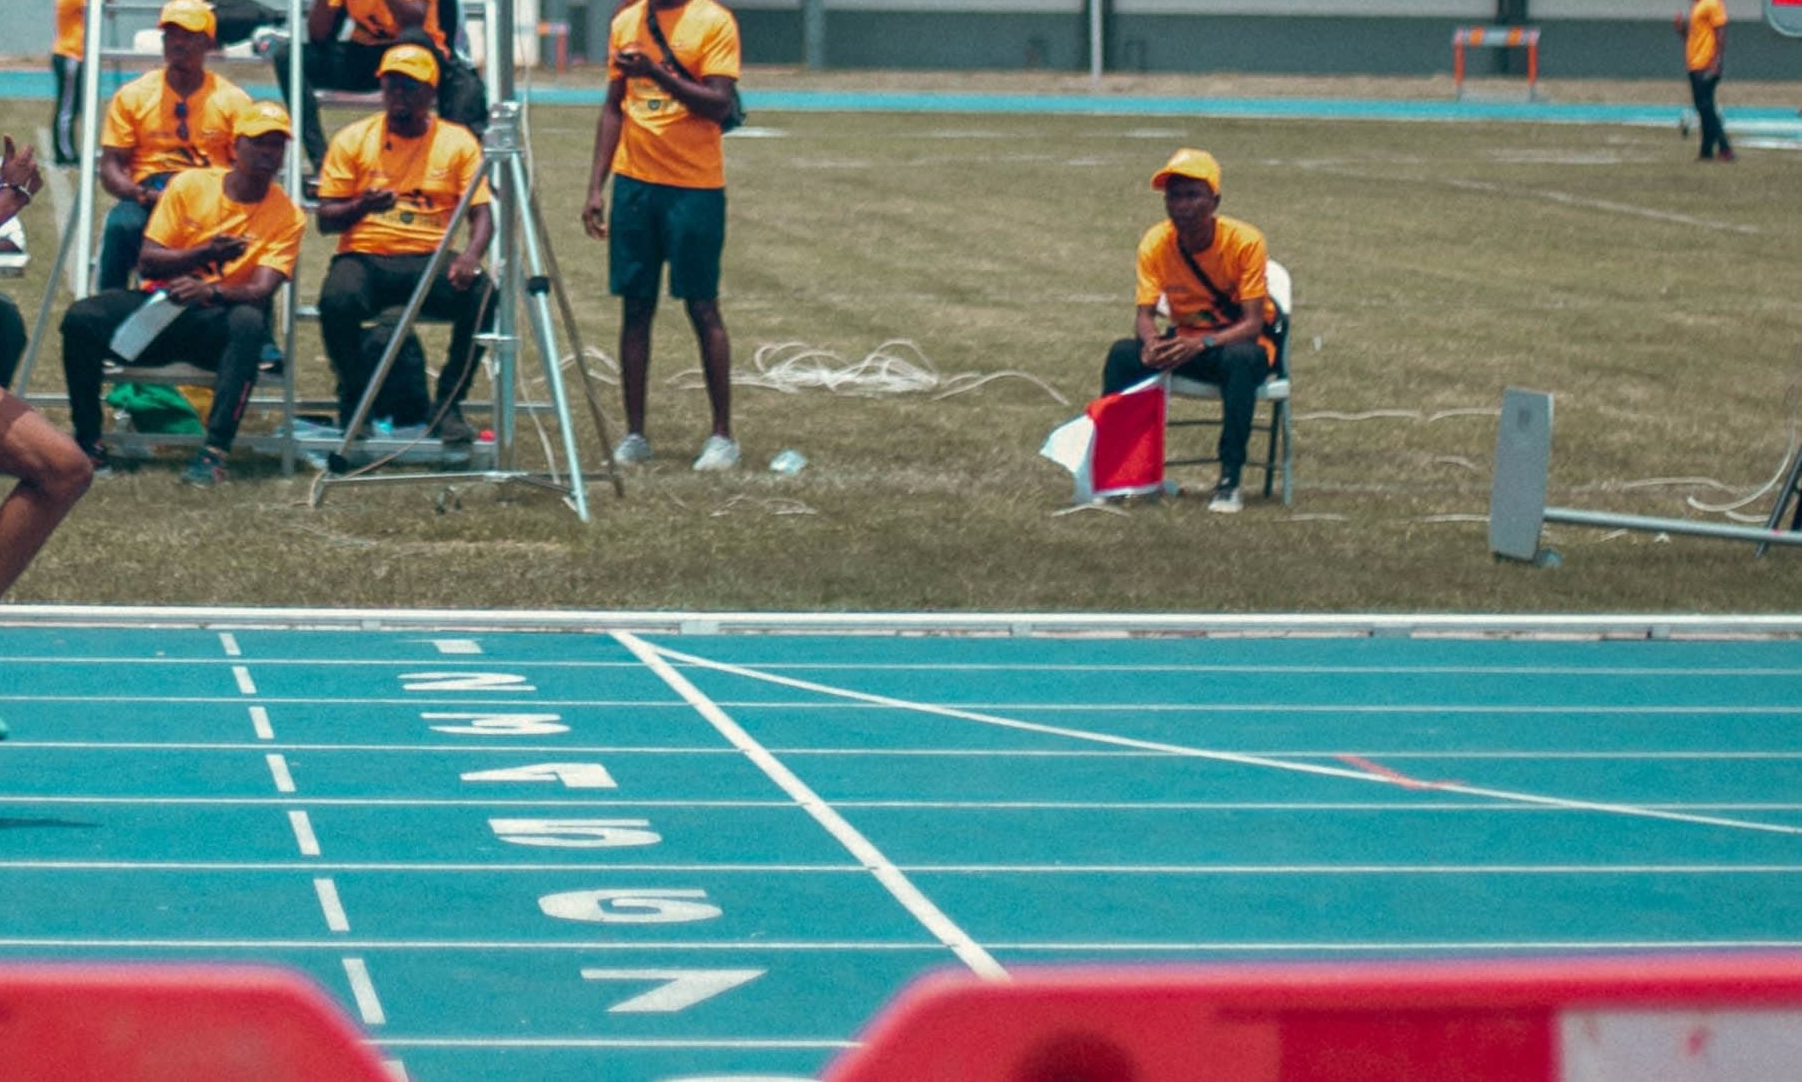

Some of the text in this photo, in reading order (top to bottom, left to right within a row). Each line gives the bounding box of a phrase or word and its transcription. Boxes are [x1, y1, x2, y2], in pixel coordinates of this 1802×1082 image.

[398, 671, 537, 691] 2
[420, 712, 571, 735] 3
[460, 762, 618, 788] 4
[487, 818, 662, 848] 5
[537, 888, 724, 923] 6
[580, 969, 769, 1012] 7
